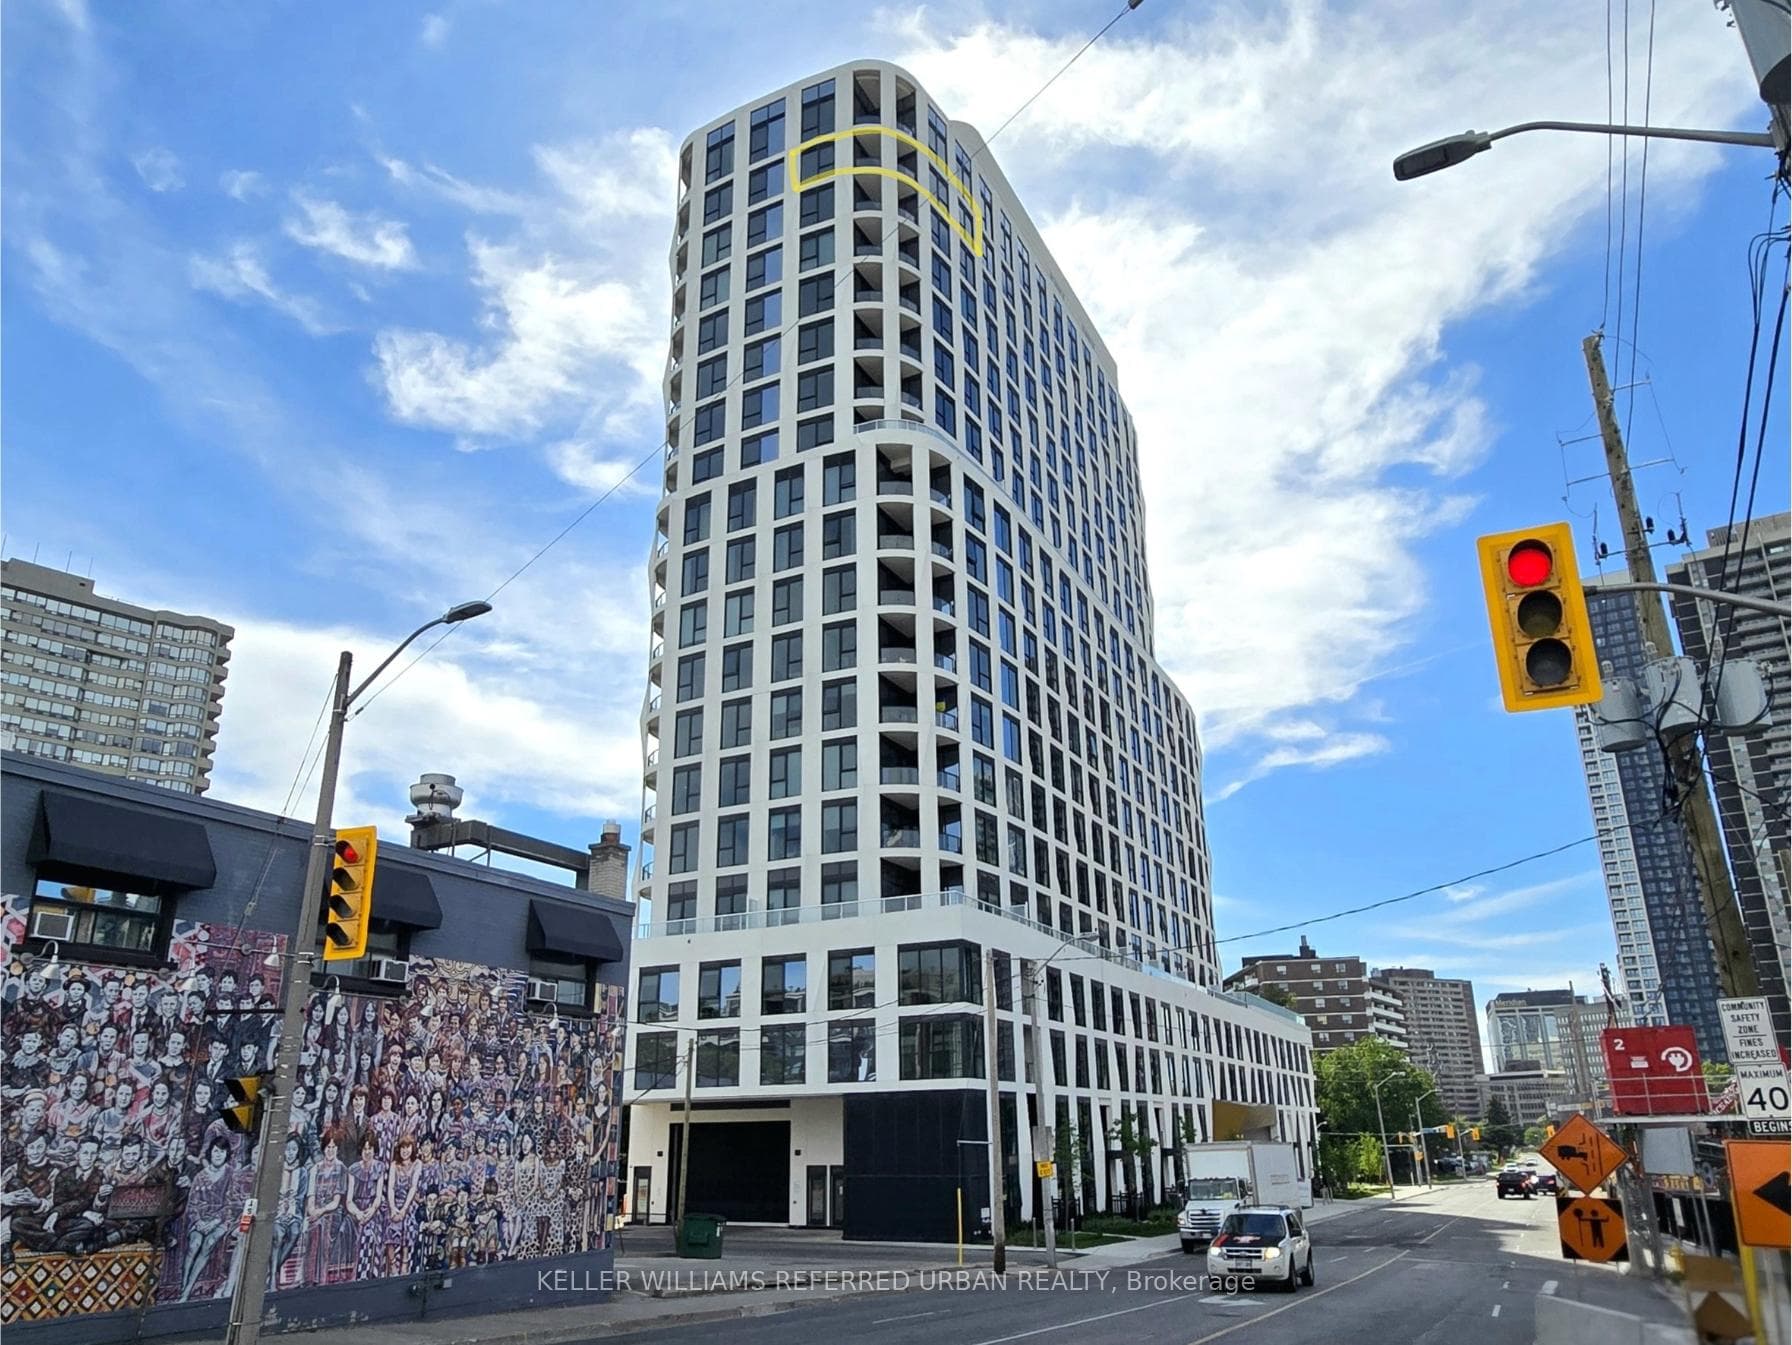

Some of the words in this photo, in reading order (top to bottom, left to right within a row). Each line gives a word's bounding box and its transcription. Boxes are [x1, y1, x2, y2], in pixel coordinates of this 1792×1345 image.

[1721, 1001, 1764, 1011] COMMUNITY
[1730, 1013, 1760, 1022] SAFETY
[1737, 1025, 1759, 1034] ZONE
[1613, 1038, 1625, 1051] 2
[1739, 1038, 1764, 1047] FINES
[1731, 1049, 1777, 1058] INCREASED
[1740, 1070, 1783, 1079] MAXIMUM
[1747, 1086, 1789, 1111] 40
